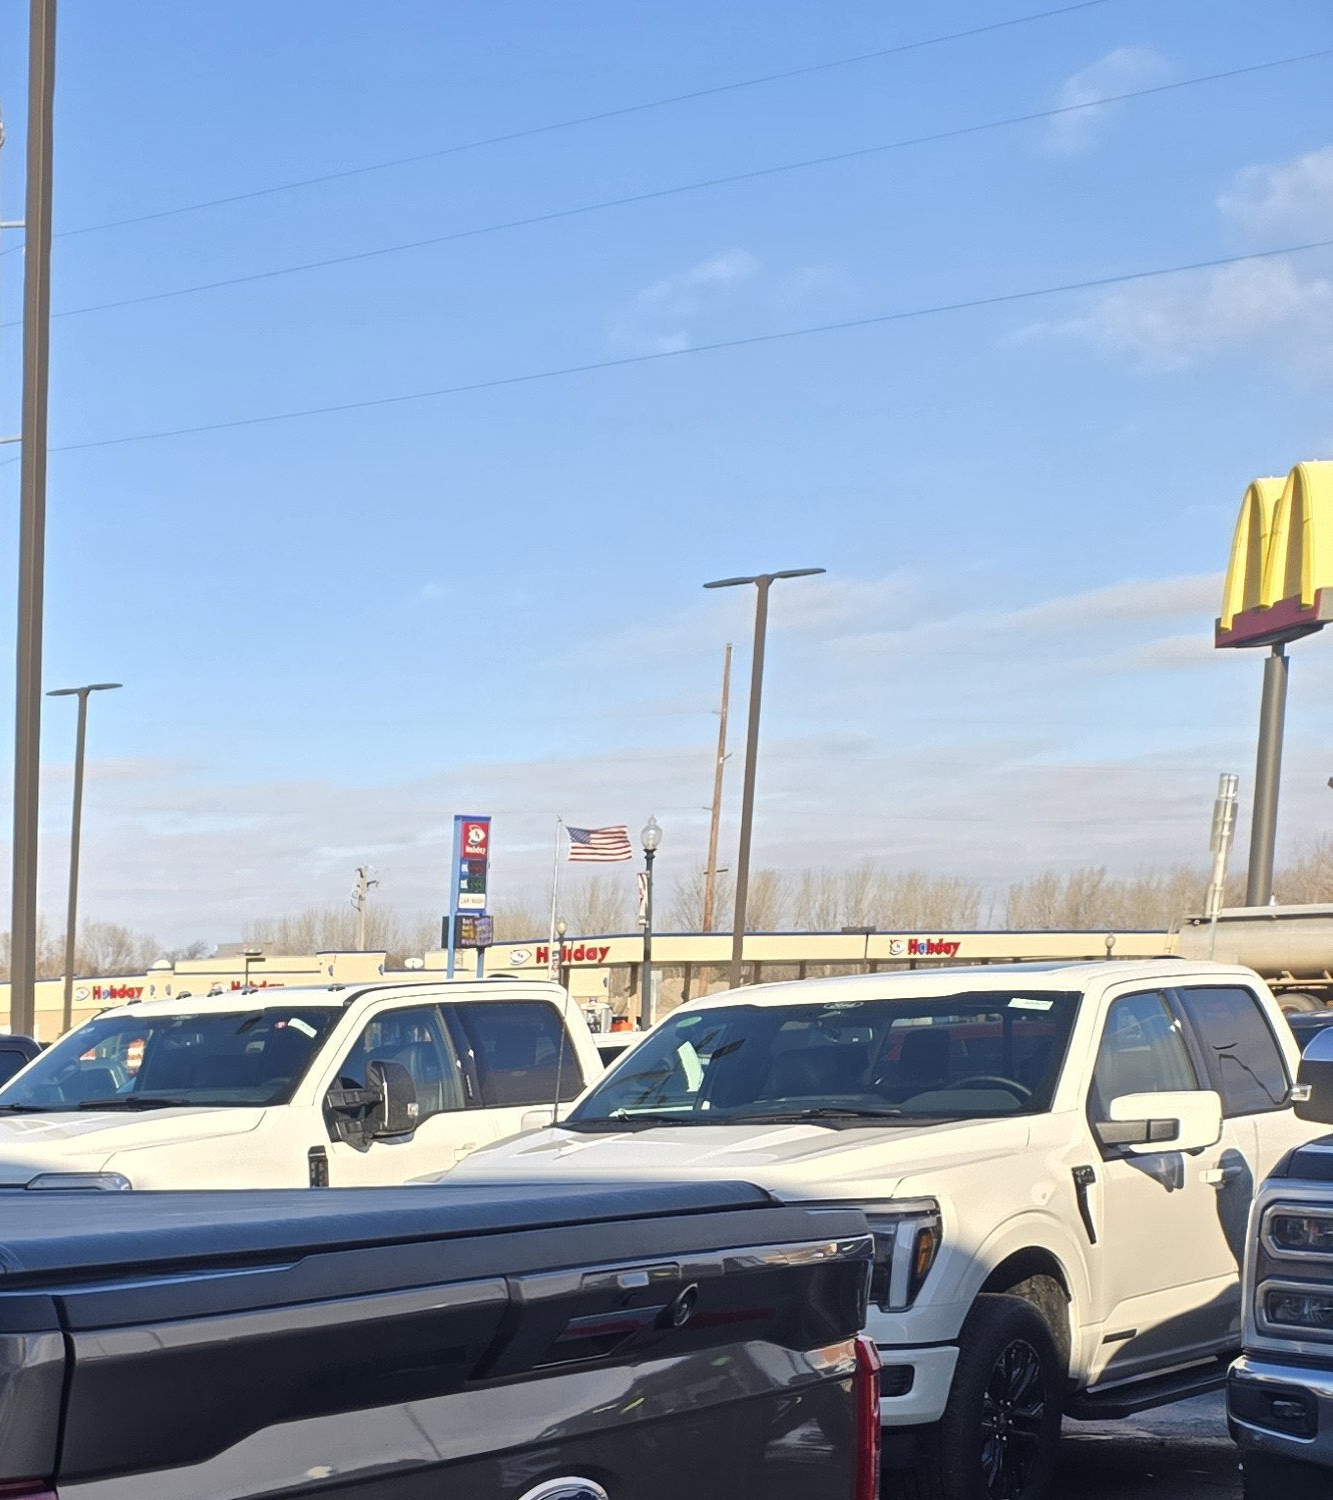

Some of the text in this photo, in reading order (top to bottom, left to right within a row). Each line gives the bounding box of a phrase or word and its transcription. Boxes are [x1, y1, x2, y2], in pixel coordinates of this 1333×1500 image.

[536, 945, 611, 963] Hliday
[907, 938, 961, 957] Holiday
[93, 984, 144, 1000] Holiday
